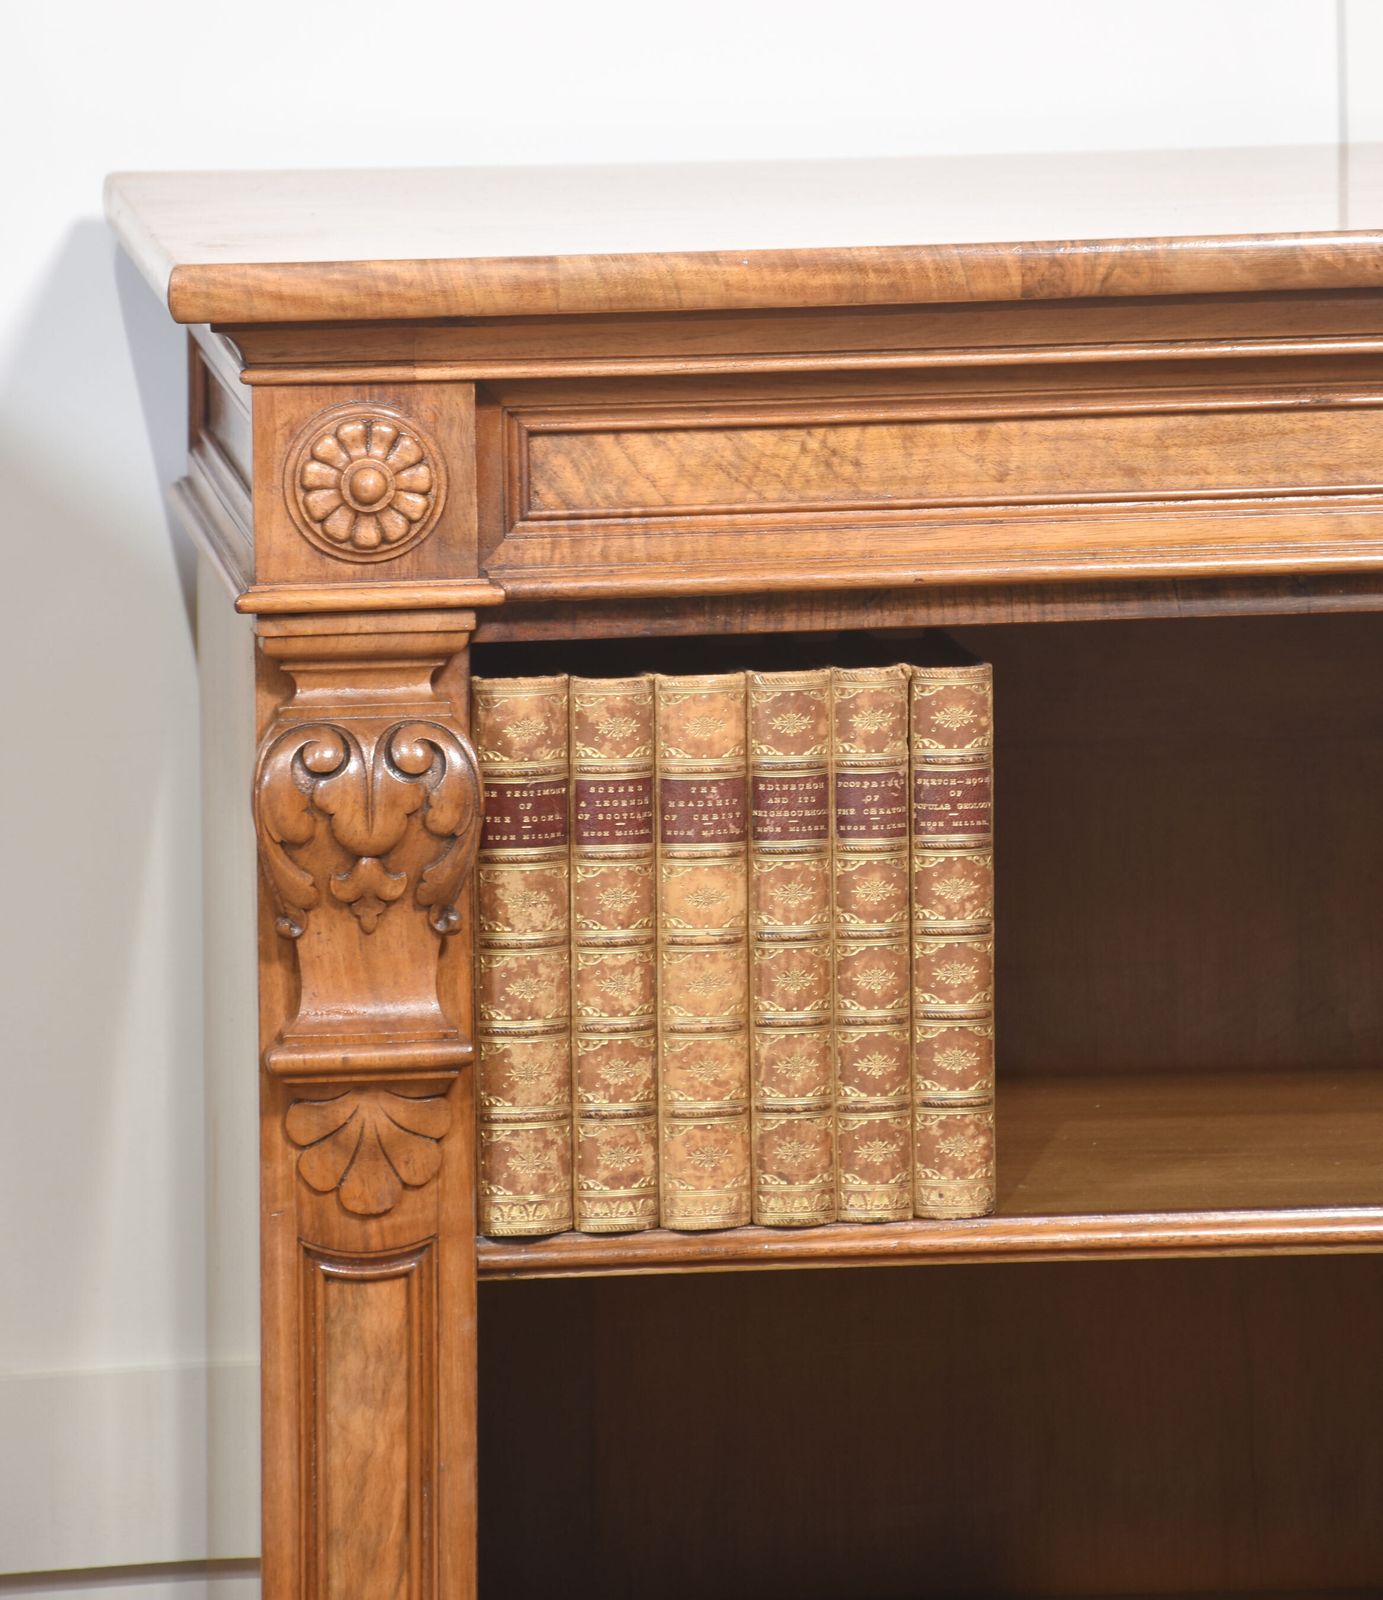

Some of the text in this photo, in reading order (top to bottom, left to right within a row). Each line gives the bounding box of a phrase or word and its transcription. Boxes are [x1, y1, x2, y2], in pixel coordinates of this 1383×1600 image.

[589, 785, 643, 793] SCENES
[758, 782, 824, 791] EDINBURGH
[506, 787, 566, 798] TESTIMONY
[595, 796, 649, 807] LEGENDS
[668, 799, 738, 807] HEADSHIP
[957, 802, 991, 810] GEOLOGY
[598, 811, 652, 820] SCOTLAND
[753, 809, 827, 817] NEIGHBOURHOO
